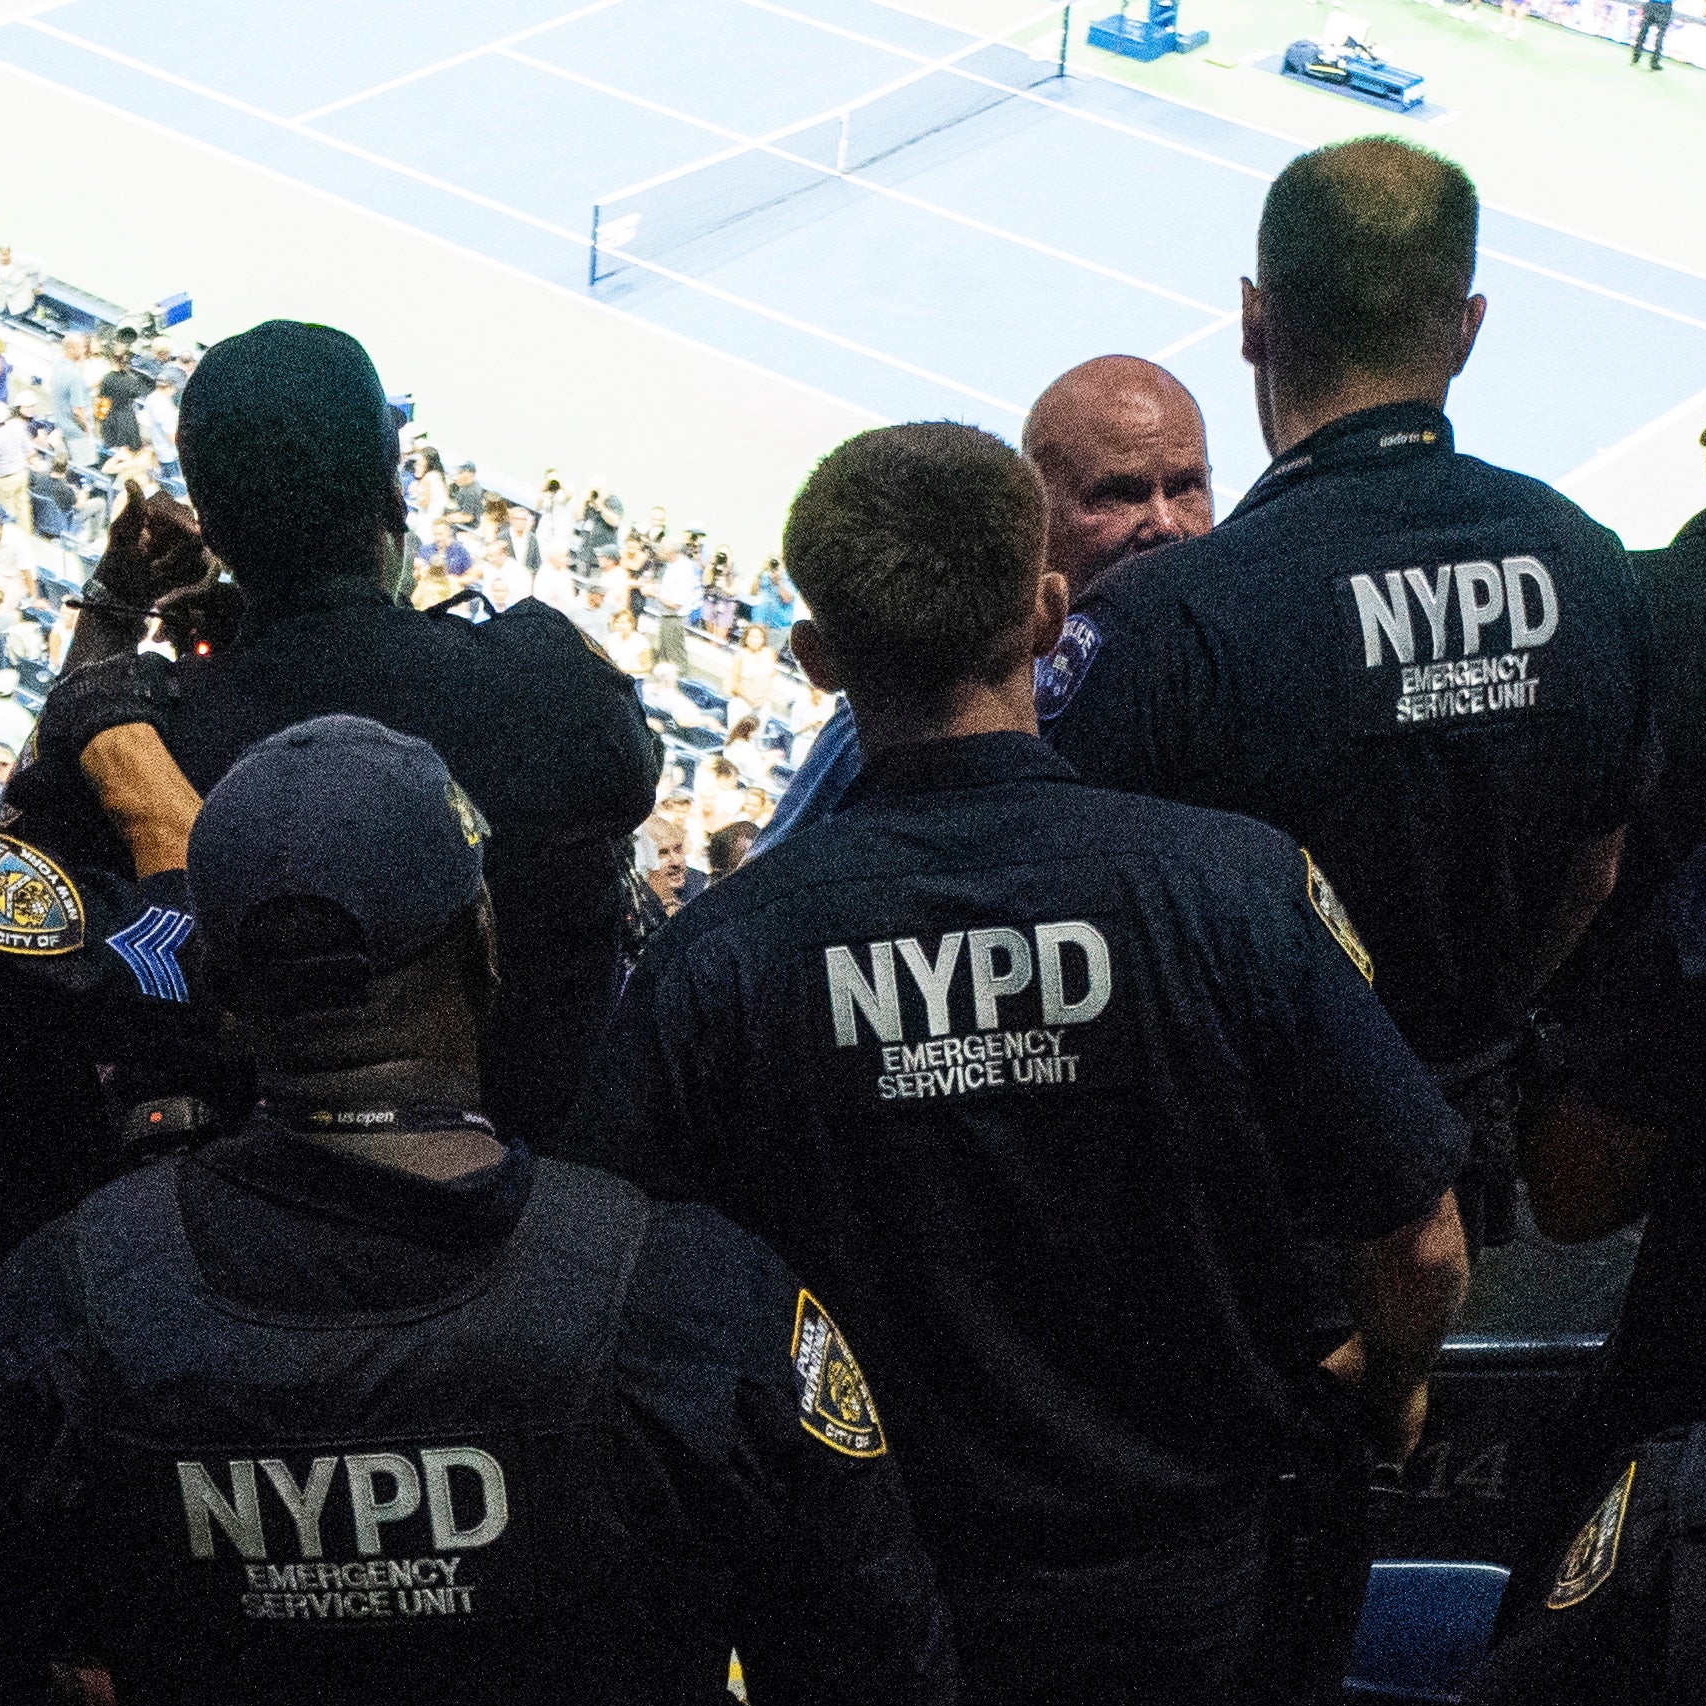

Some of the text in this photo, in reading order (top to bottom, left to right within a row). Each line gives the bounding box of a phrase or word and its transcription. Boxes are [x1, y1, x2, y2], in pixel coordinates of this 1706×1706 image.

[1350, 555, 1559, 668] NYPD
[1402, 652, 1530, 694] EMERGENCY
[1397, 676, 1540, 723] SERVICE UNIT
[37, 934, 60, 948] OF
[825, 920, 1112, 1047] NYPD
[882, 1029, 1065, 1072] EMERGENCY
[878, 1055, 1080, 1100] SERVICE UNIT
[355, 1110, 395, 1127] open
[176, 1445, 510, 1560] NYPD
[243, 1556, 462, 1591] EMERGENCY
[240, 1584, 476, 1621] SERVICE UNIT
